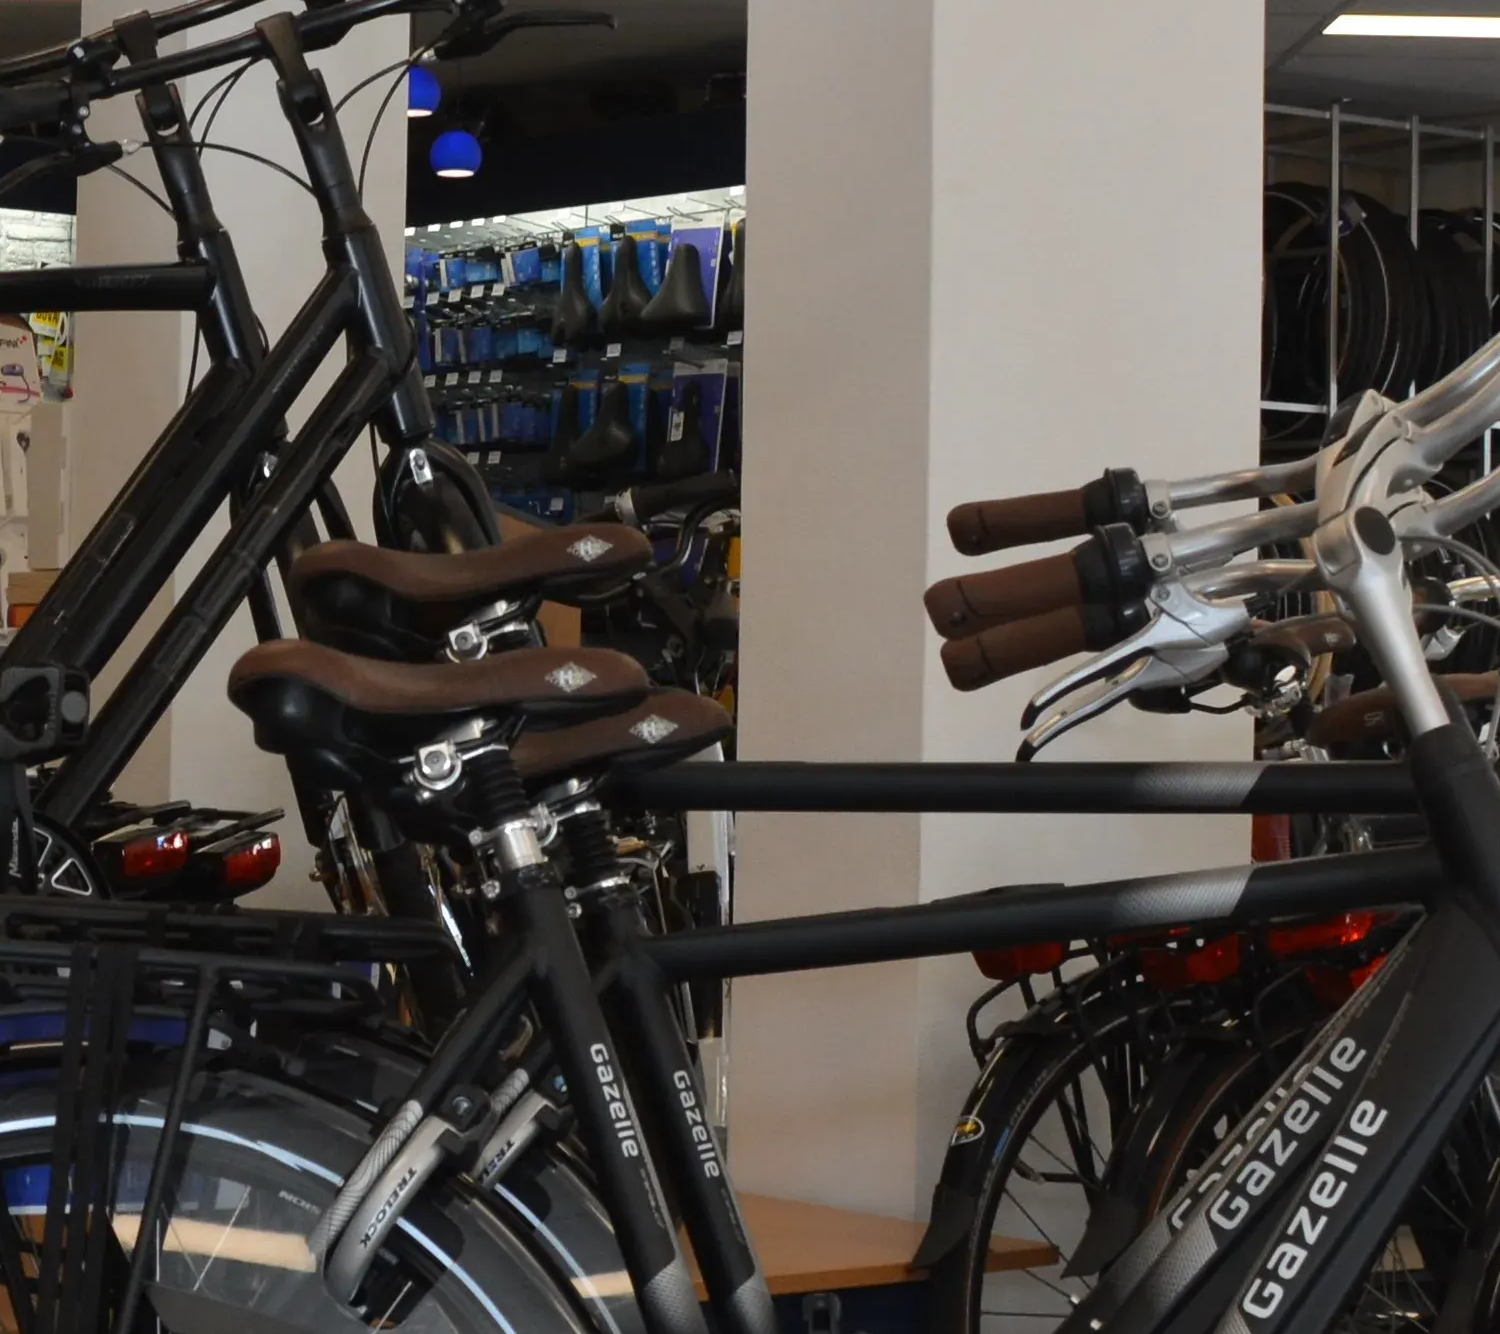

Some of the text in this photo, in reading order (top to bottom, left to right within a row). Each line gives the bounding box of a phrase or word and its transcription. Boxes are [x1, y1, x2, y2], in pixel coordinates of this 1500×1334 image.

[589, 1042, 640, 1160] Gazelle
[672, 1069, 721, 1180] Gazelle
[1209, 1034, 1368, 1231] Gazelle
[359, 1168, 418, 1250] TRELOCK
[1242, 1097, 1388, 1320] Gazelle
